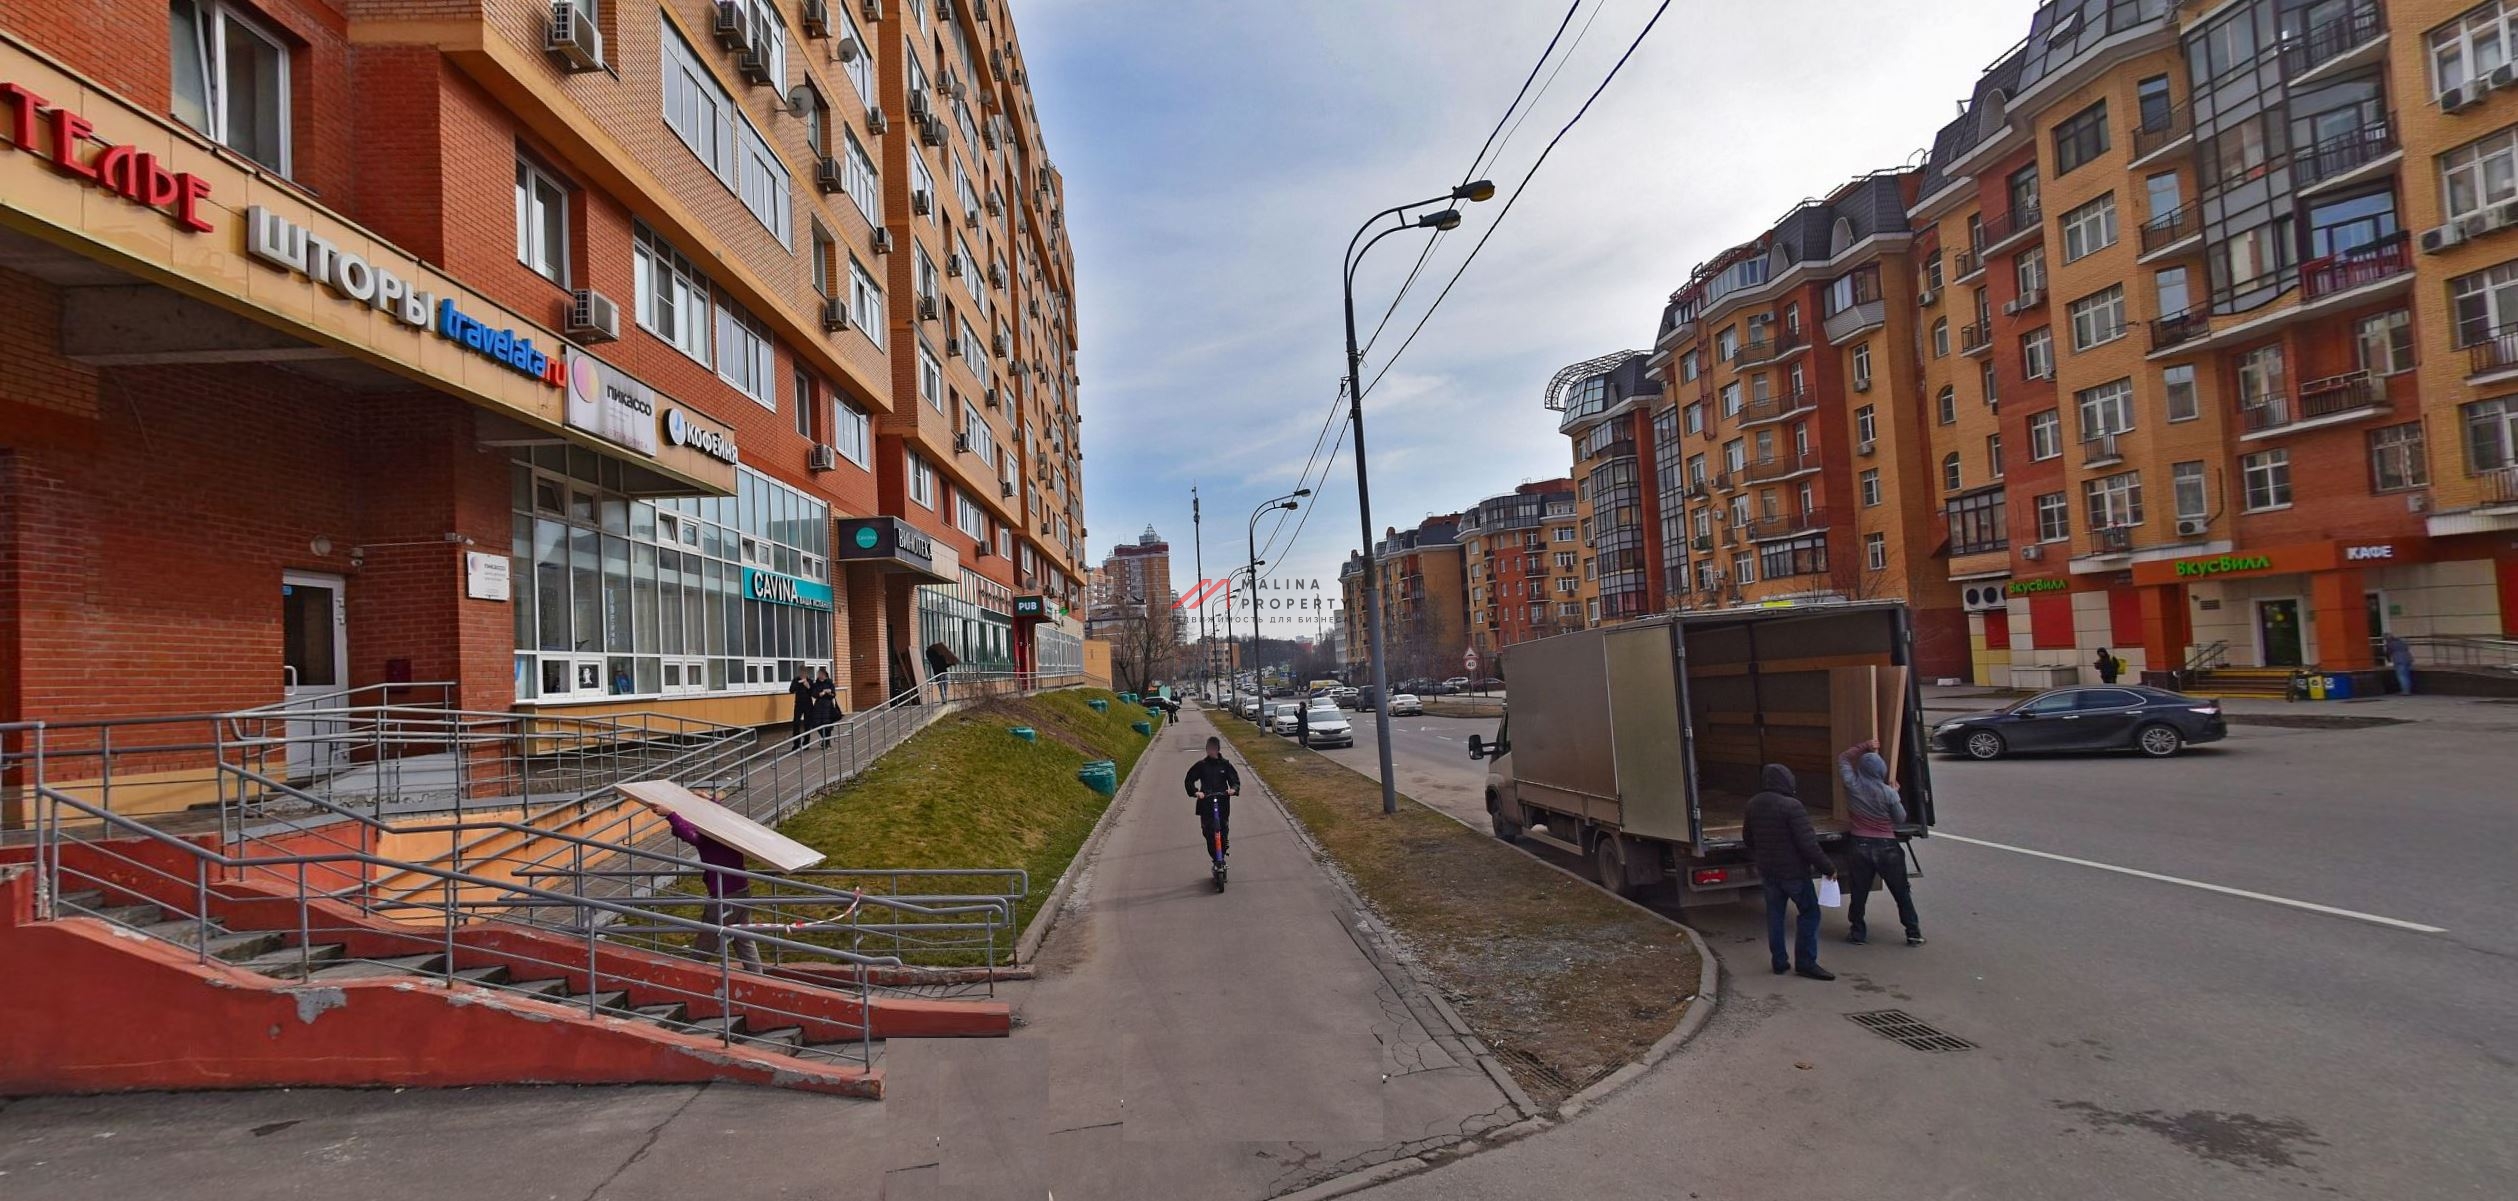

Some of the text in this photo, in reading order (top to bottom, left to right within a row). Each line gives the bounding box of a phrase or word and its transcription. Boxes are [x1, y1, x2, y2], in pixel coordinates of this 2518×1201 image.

[247, 205, 435, 332] ШТОРЫ
[607, 385, 652, 416] пикассо
[685, 421, 738, 464] КОФЕЙНЯ
[2347, 545, 2393, 559] КАФЕ
[754, 571, 799, 604] CAVINA
[1018, 602, 1037, 610] PUB
